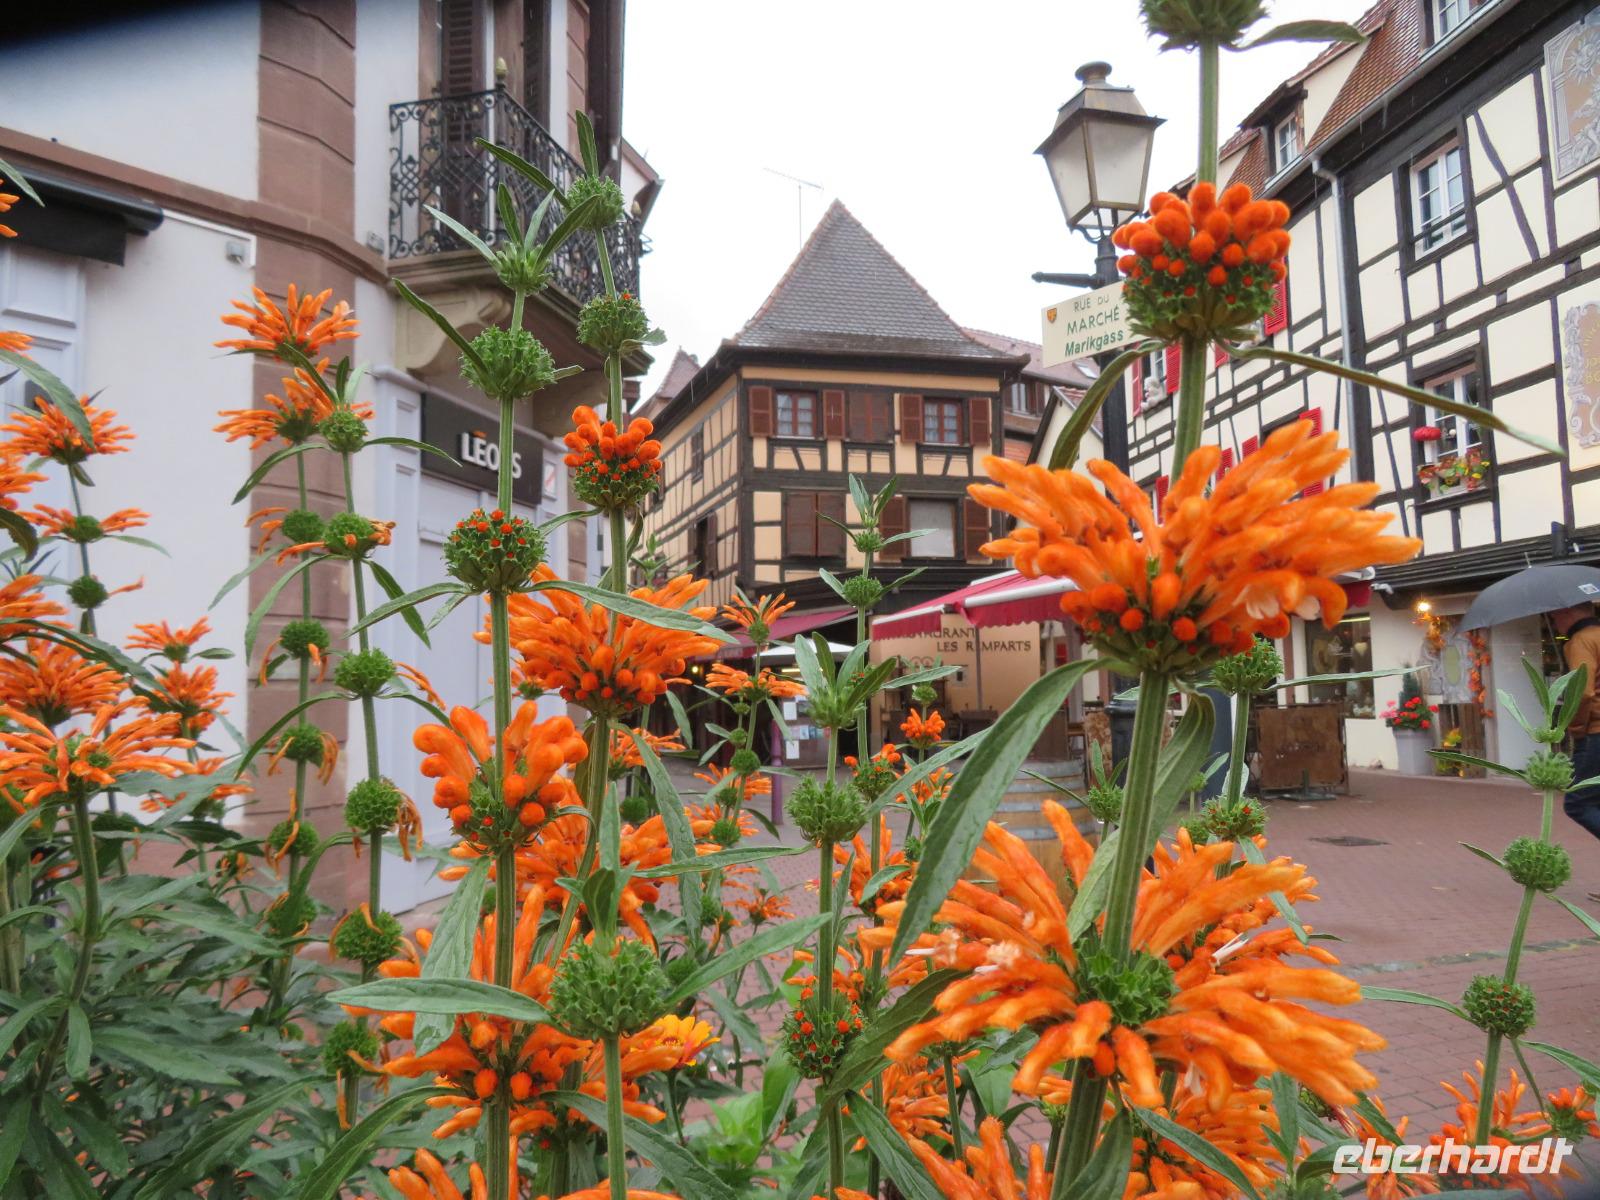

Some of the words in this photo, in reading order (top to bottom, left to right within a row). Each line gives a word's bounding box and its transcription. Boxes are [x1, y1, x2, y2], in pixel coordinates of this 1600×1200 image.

[1074, 297, 1091, 312] RUE
[1097, 294, 1110, 305] DU
[1066, 304, 1120, 335] MARCHÉ
[1064, 330, 1124, 357] Marikgass
[936, 641, 959, 652] LES
[966, 640, 1031, 652] RMPARTS
